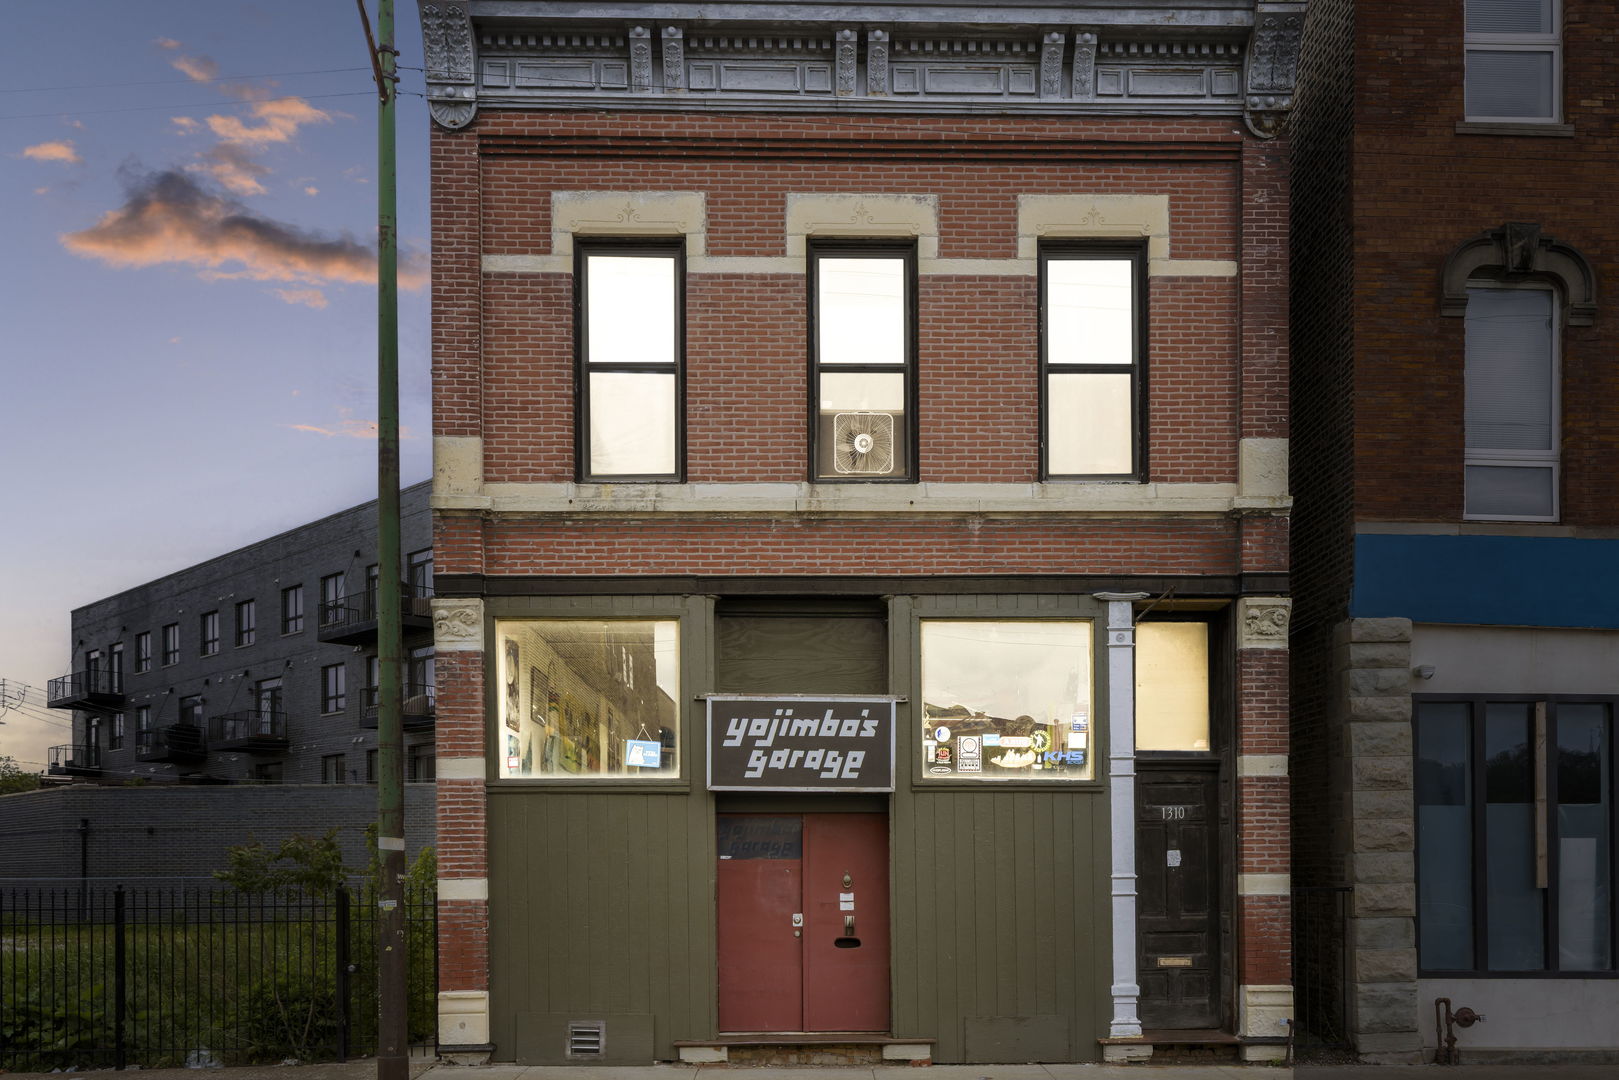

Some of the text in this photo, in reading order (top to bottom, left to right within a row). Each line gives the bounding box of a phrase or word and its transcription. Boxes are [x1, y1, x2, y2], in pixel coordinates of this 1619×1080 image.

[722, 708, 879, 747] yojimbo's
[744, 748, 866, 779] garage
[1043, 751, 1084, 761] KHS
[1162, 806, 1185, 820] 1310
